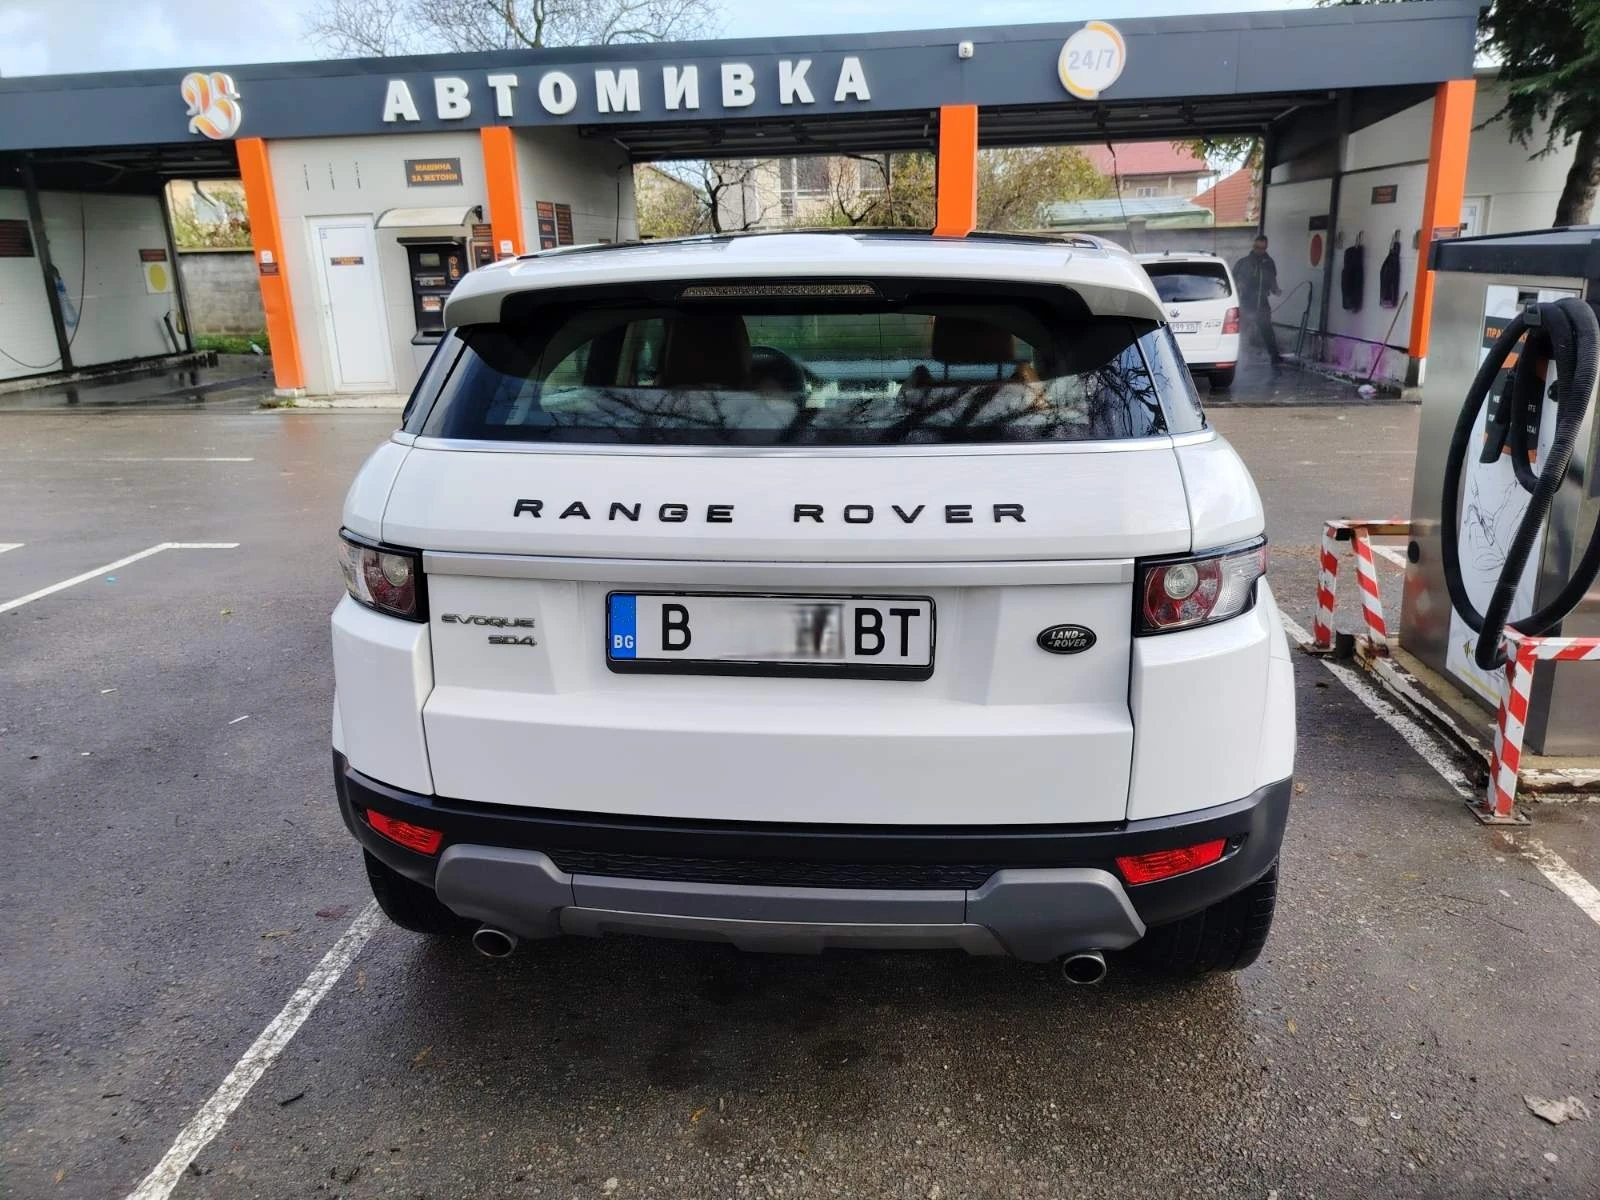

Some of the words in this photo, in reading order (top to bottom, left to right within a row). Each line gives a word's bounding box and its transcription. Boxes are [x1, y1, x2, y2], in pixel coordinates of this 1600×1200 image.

[1068, 48, 1115, 71] 24/7
[383, 56, 871, 122] АВТОМИВКА
[513, 498, 735, 523] RANGE
[793, 504, 1026, 523] ROVER
[441, 613, 535, 628] EVOQUE
[488, 635, 537, 646] SD4
[613, 634, 634, 649] BG
[1051, 630, 1079, 640] LAND
[1053, 638, 1088, 648] ROVER
